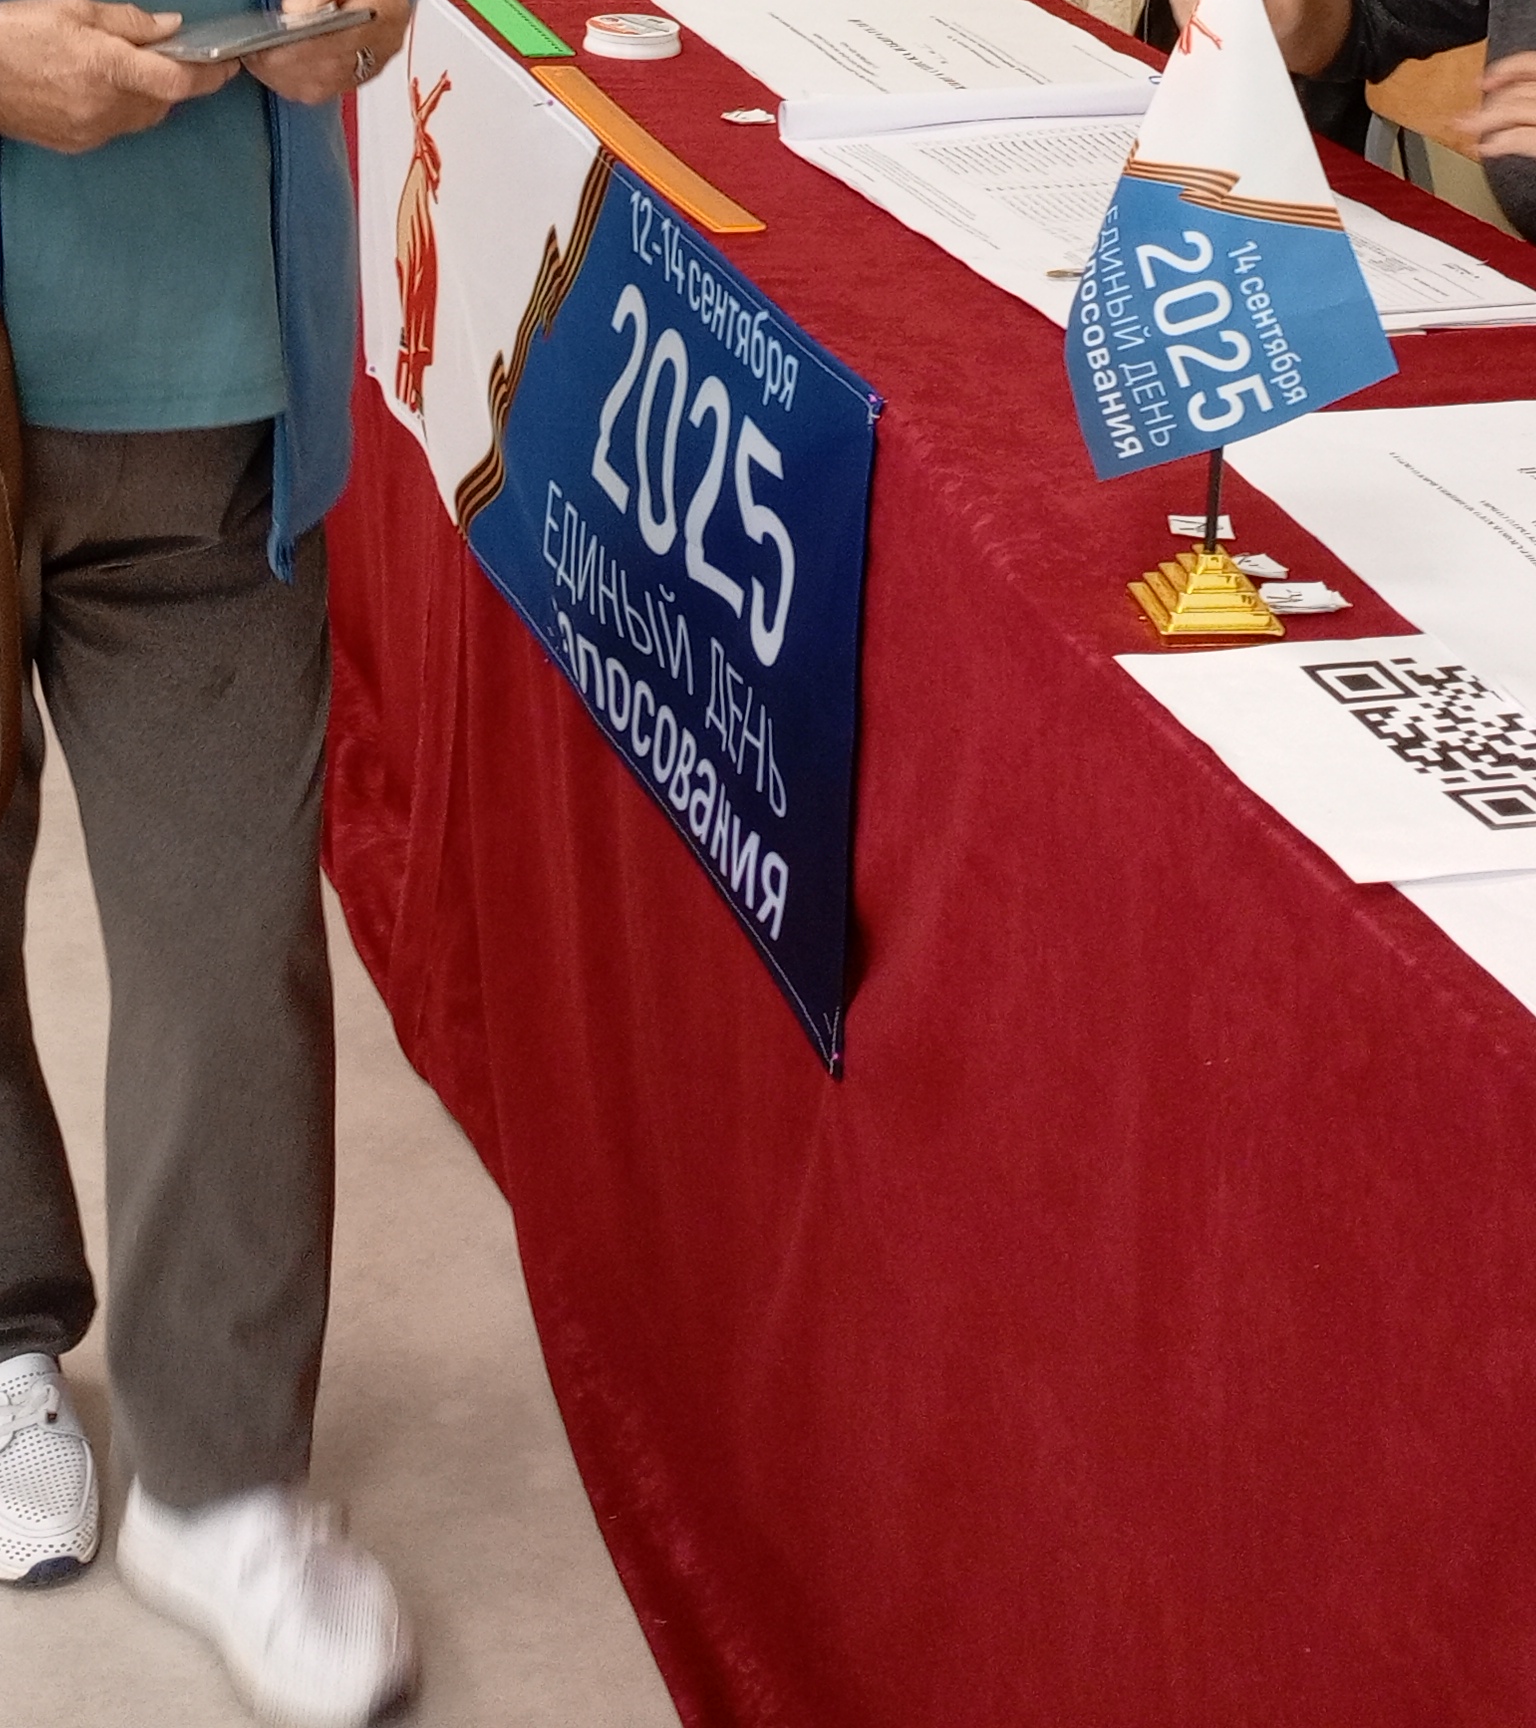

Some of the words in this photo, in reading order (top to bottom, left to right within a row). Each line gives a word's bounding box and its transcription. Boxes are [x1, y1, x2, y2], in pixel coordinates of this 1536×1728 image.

[629, 189, 686, 297] 12-14
[686, 259, 800, 412] сентября
[1080, 257, 1144, 461] лосования
[1098, 204, 1152, 351] ЕДИНЫЙ
[1135, 229, 1274, 434] 2025
[1227, 240, 1252, 277] 14
[1238, 280, 1309, 406] сентября
[591, 283, 796, 667] 2025
[1118, 355, 1178, 448] ДЕНЬ
[543, 479, 694, 696] ЕДИНЫЙ
[705, 636, 788, 819] ДЕНЬ
[558, 610, 790, 942] лосования
